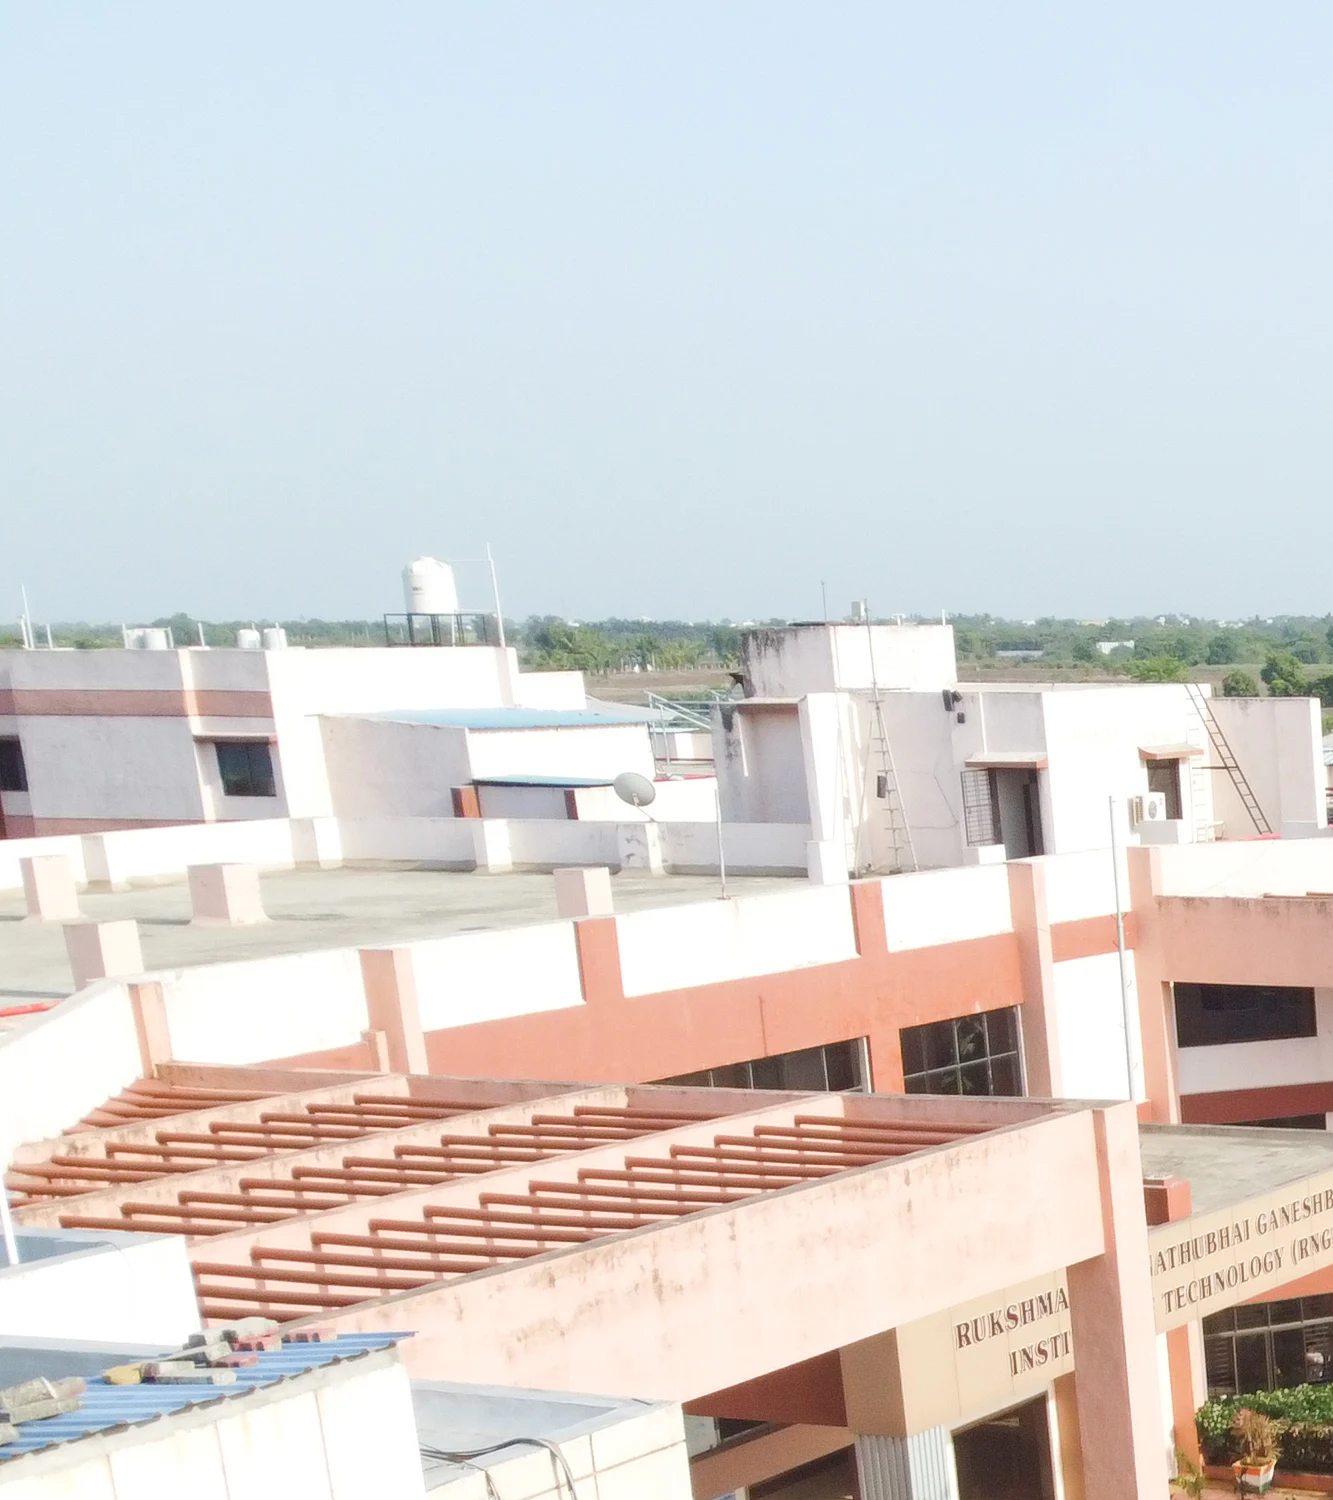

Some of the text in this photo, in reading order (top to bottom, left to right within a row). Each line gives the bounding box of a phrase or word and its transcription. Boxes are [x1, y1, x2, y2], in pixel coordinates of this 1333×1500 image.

[953, 1286, 1069, 1350] RUKSHMA
[1149, 1217, 1251, 1277] ATHUBHAI
[1009, 1330, 1071, 1377] INSTI
[1161, 1246, 1285, 1315] TECHNOLOGY
